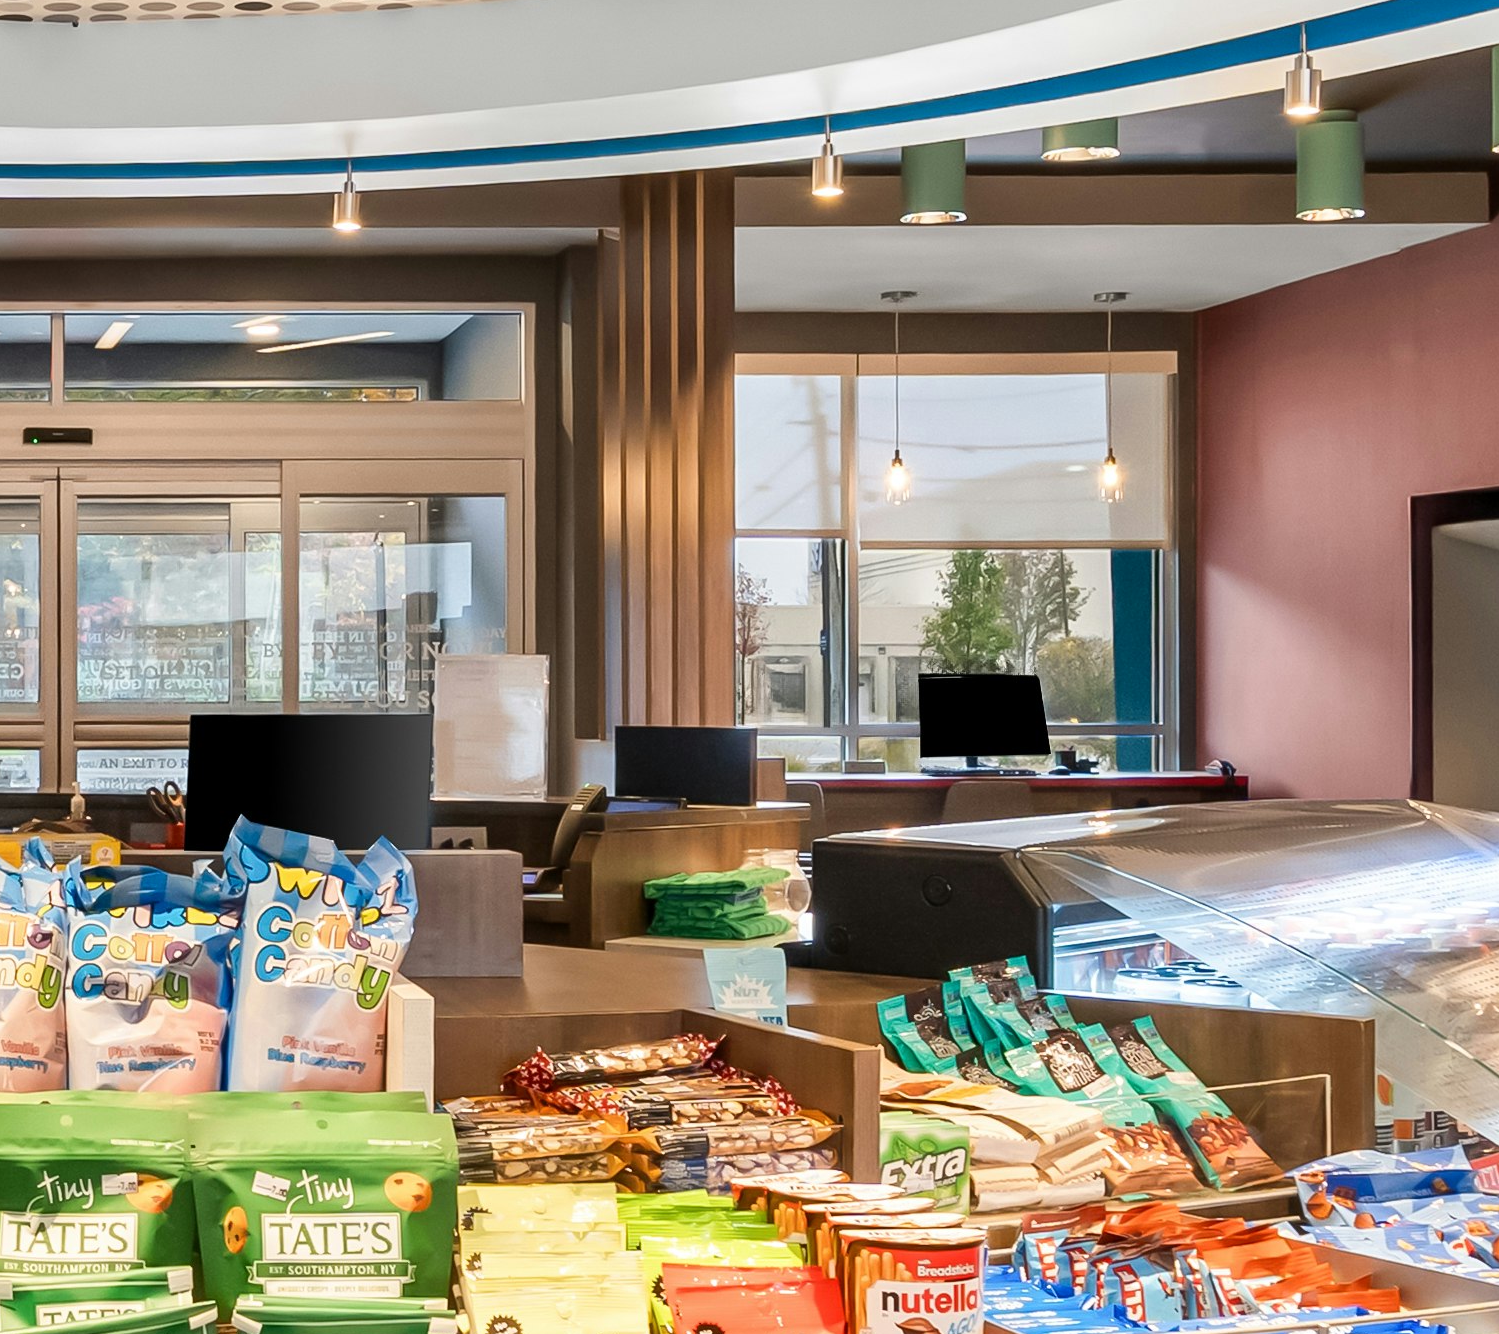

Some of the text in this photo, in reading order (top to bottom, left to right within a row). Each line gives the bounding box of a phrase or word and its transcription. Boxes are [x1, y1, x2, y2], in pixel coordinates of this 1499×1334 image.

[99, 758, 119, 769] AN
[122, 758, 155, 769] EXIT
[160, 758, 178, 769] TO
[254, 944, 391, 1010] Candy
[267, 1047, 295, 1062] Blue
[880, 1147, 967, 1191] Extra
[37, 1170, 95, 1210] tiny
[295, 1169, 355, 1210] tiny
[7, 1219, 129, 1255] TATE'S
[268, 1220, 393, 1256] TATE'S
[380, 1264, 398, 1275] NY
[916, 1262, 975, 1278] Breadsticks
[880, 1283, 979, 1315] nutella
[1117, 1267, 1144, 1323] CLIF
